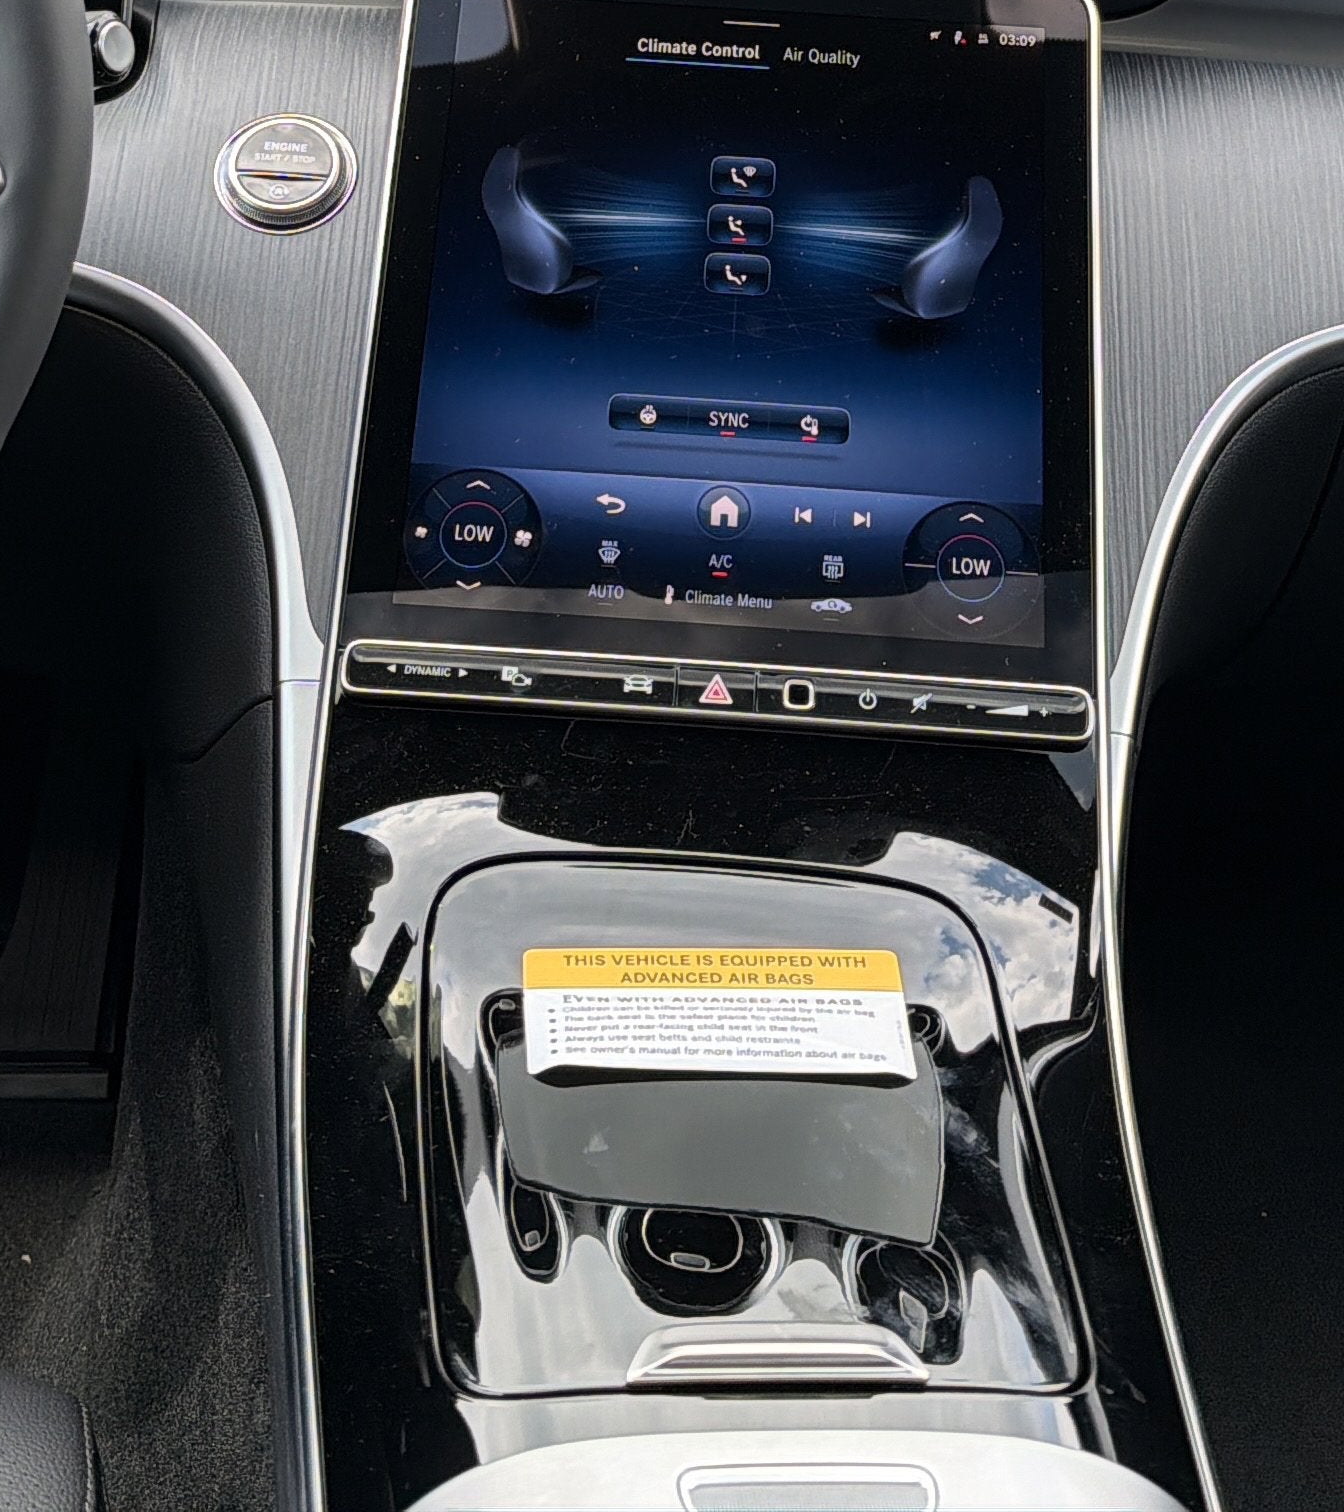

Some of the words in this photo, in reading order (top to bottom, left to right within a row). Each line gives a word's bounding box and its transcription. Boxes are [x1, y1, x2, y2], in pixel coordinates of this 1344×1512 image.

[999, 33, 1036, 47] 03:09
[637, 37, 697, 56] Climate
[701, 41, 760, 60] Control
[783, 47, 804, 62] Air
[808, 48, 861, 69] Quality
[263, 141, 309, 152] ENGINE
[254, 152, 283, 162] START
[293, 154, 316, 163] STOP
[708, 410, 749, 431] SYNC
[454, 523, 495, 543] LOW
[709, 554, 733, 569] A/C
[823, 554, 844, 563] REAR
[951, 555, 991, 578] LOW
[588, 583, 625, 600] AUTO
[685, 589, 734, 607] Climate
[737, 592, 773, 609] Menu
[404, 664, 452, 677] DYNAMIC
[563, 954, 606, 966] THIS
[611, 954, 691, 967] VEHICLE
[696, 955, 714, 967] IS
[719, 955, 813, 968] EQUIPPED
[817, 956, 867, 968] WITH
[620, 972, 723, 984] ADVANCED
[728, 973, 760, 985] AIR
[765, 973, 814, 985] BAGS
[562, 994, 610, 1004] EVEN
[672, 996, 772, 1004] ADVANCED
[778, 997, 808, 1005] AIR
[815, 998, 863, 1006] BAGS
[639, 1046, 681, 1055] manual
[684, 1046, 699, 1055] for
[736, 1047, 803, 1058] information
[805, 1050, 838, 1059] about
[841, 1051, 856, 1060] air
[859, 1052, 887, 1062] bags
